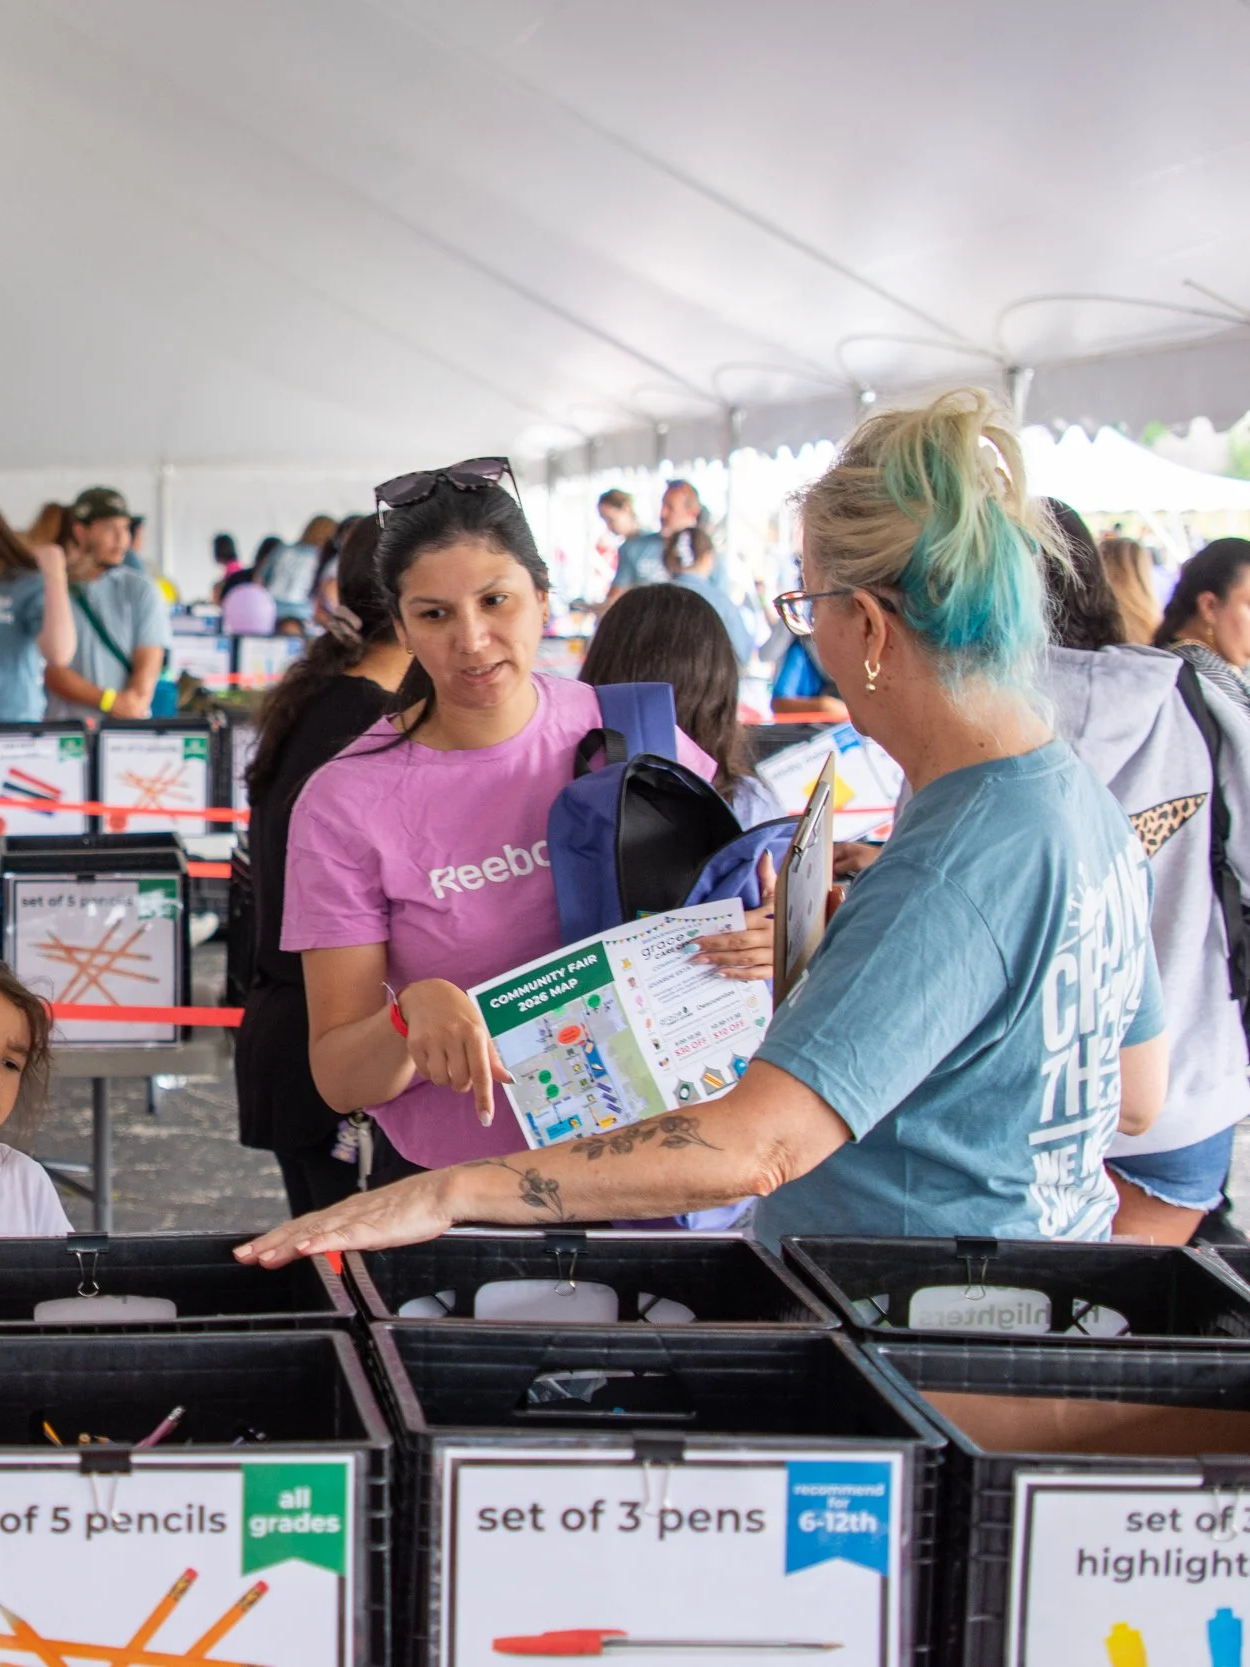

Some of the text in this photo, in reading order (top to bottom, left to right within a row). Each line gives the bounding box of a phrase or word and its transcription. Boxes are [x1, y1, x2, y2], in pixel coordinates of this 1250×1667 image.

[429, 840, 551, 899] Reebo
[22, 897, 43, 907] set
[48, 895, 63, 907] of
[68, 896, 76, 907] 5
[489, 954, 598, 1009] COMMUNITY FAIR
[517, 978, 578, 1012] 2026 MAP
[278, 1487, 311, 1510] all
[792, 1483, 885, 1497] recommend
[827, 1496, 850, 1510] for
[0, 1506, 38, 1534] of
[51, 1508, 72, 1534] 5
[86, 1504, 227, 1540] pencils
[249, 1511, 340, 1539] grades
[478, 1499, 765, 1541] set of 3 pens
[798, 1510, 879, 1534] 6-12th
[1126, 1508, 1182, 1533] set
[1195, 1505, 1235, 1533] of
[1077, 1547, 1250, 1584] highlight
